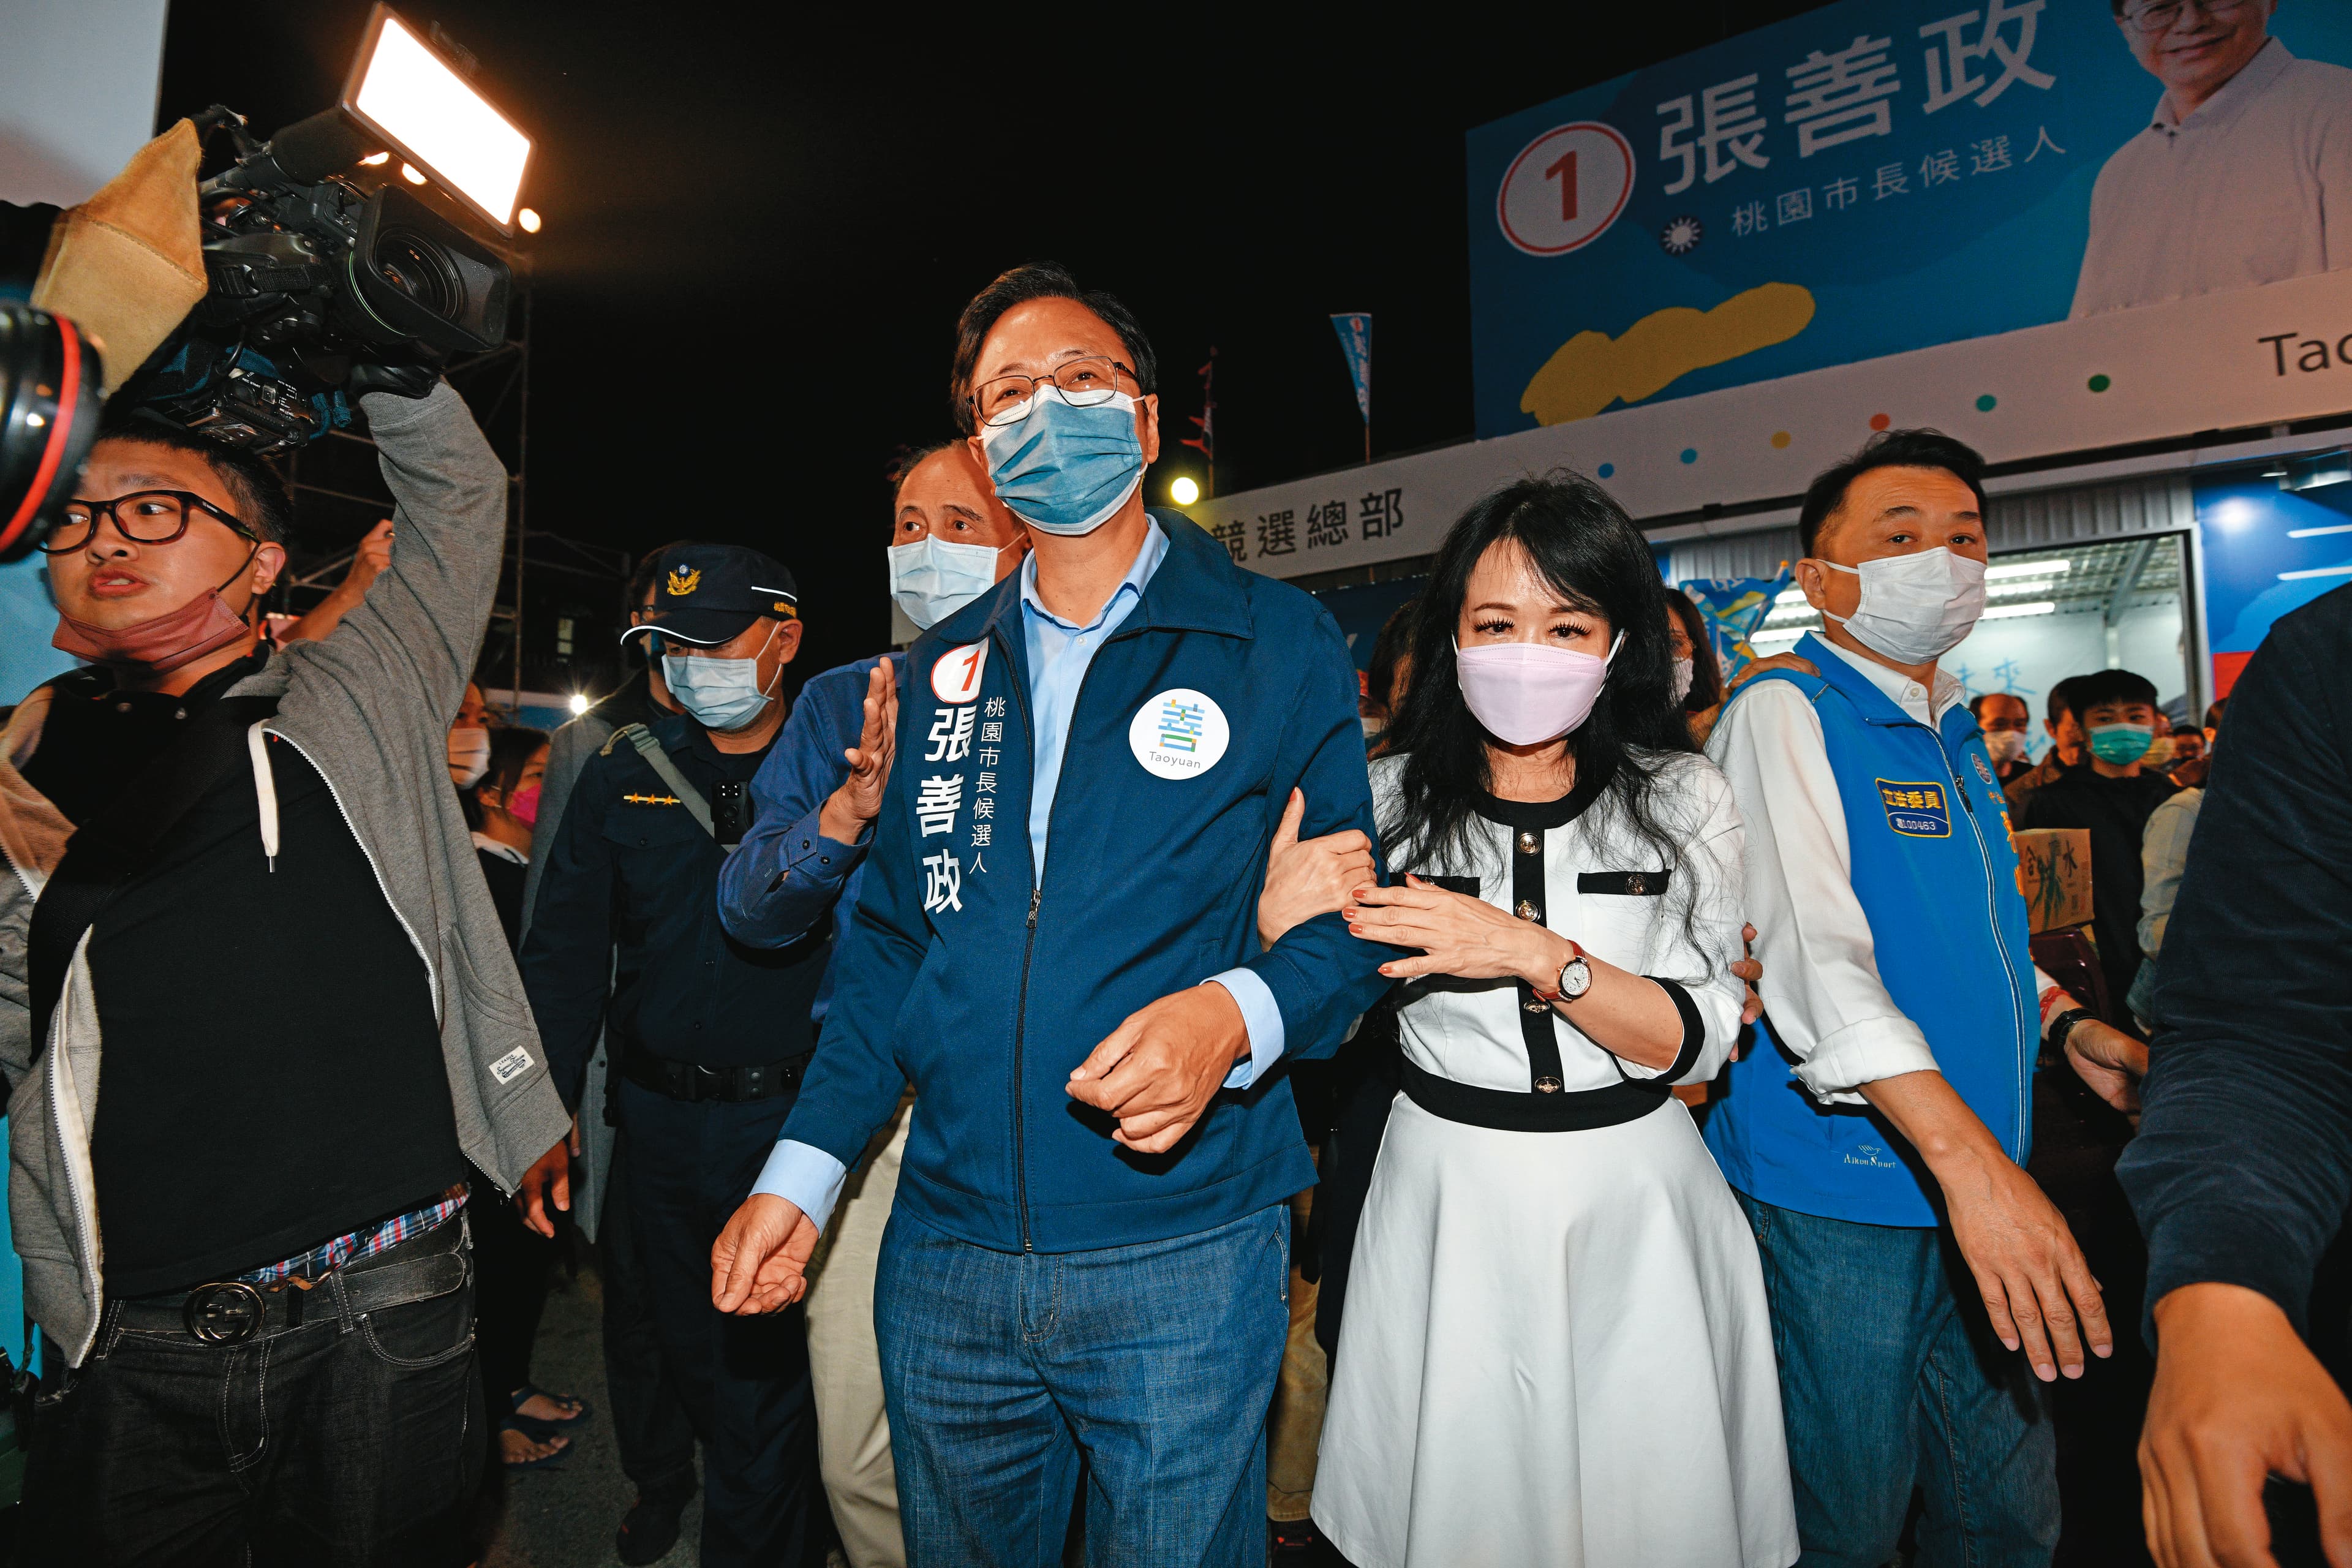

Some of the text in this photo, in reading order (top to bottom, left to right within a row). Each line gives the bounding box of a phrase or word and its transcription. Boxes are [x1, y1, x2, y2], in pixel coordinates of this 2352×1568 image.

[1656, 0, 2057, 196] 張善政
[1545, 149, 1578, 222] 1
[1730, 125, 2067, 237] 桃園市長候選人
[1210, 487, 1404, 562] 競選總部
[960, 649, 981, 692] 1
[968, 696, 1006, 875] 桃園市長候選人
[1149, 751, 1202, 769] Taoyuan
[916, 704, 978, 914] 張善政
